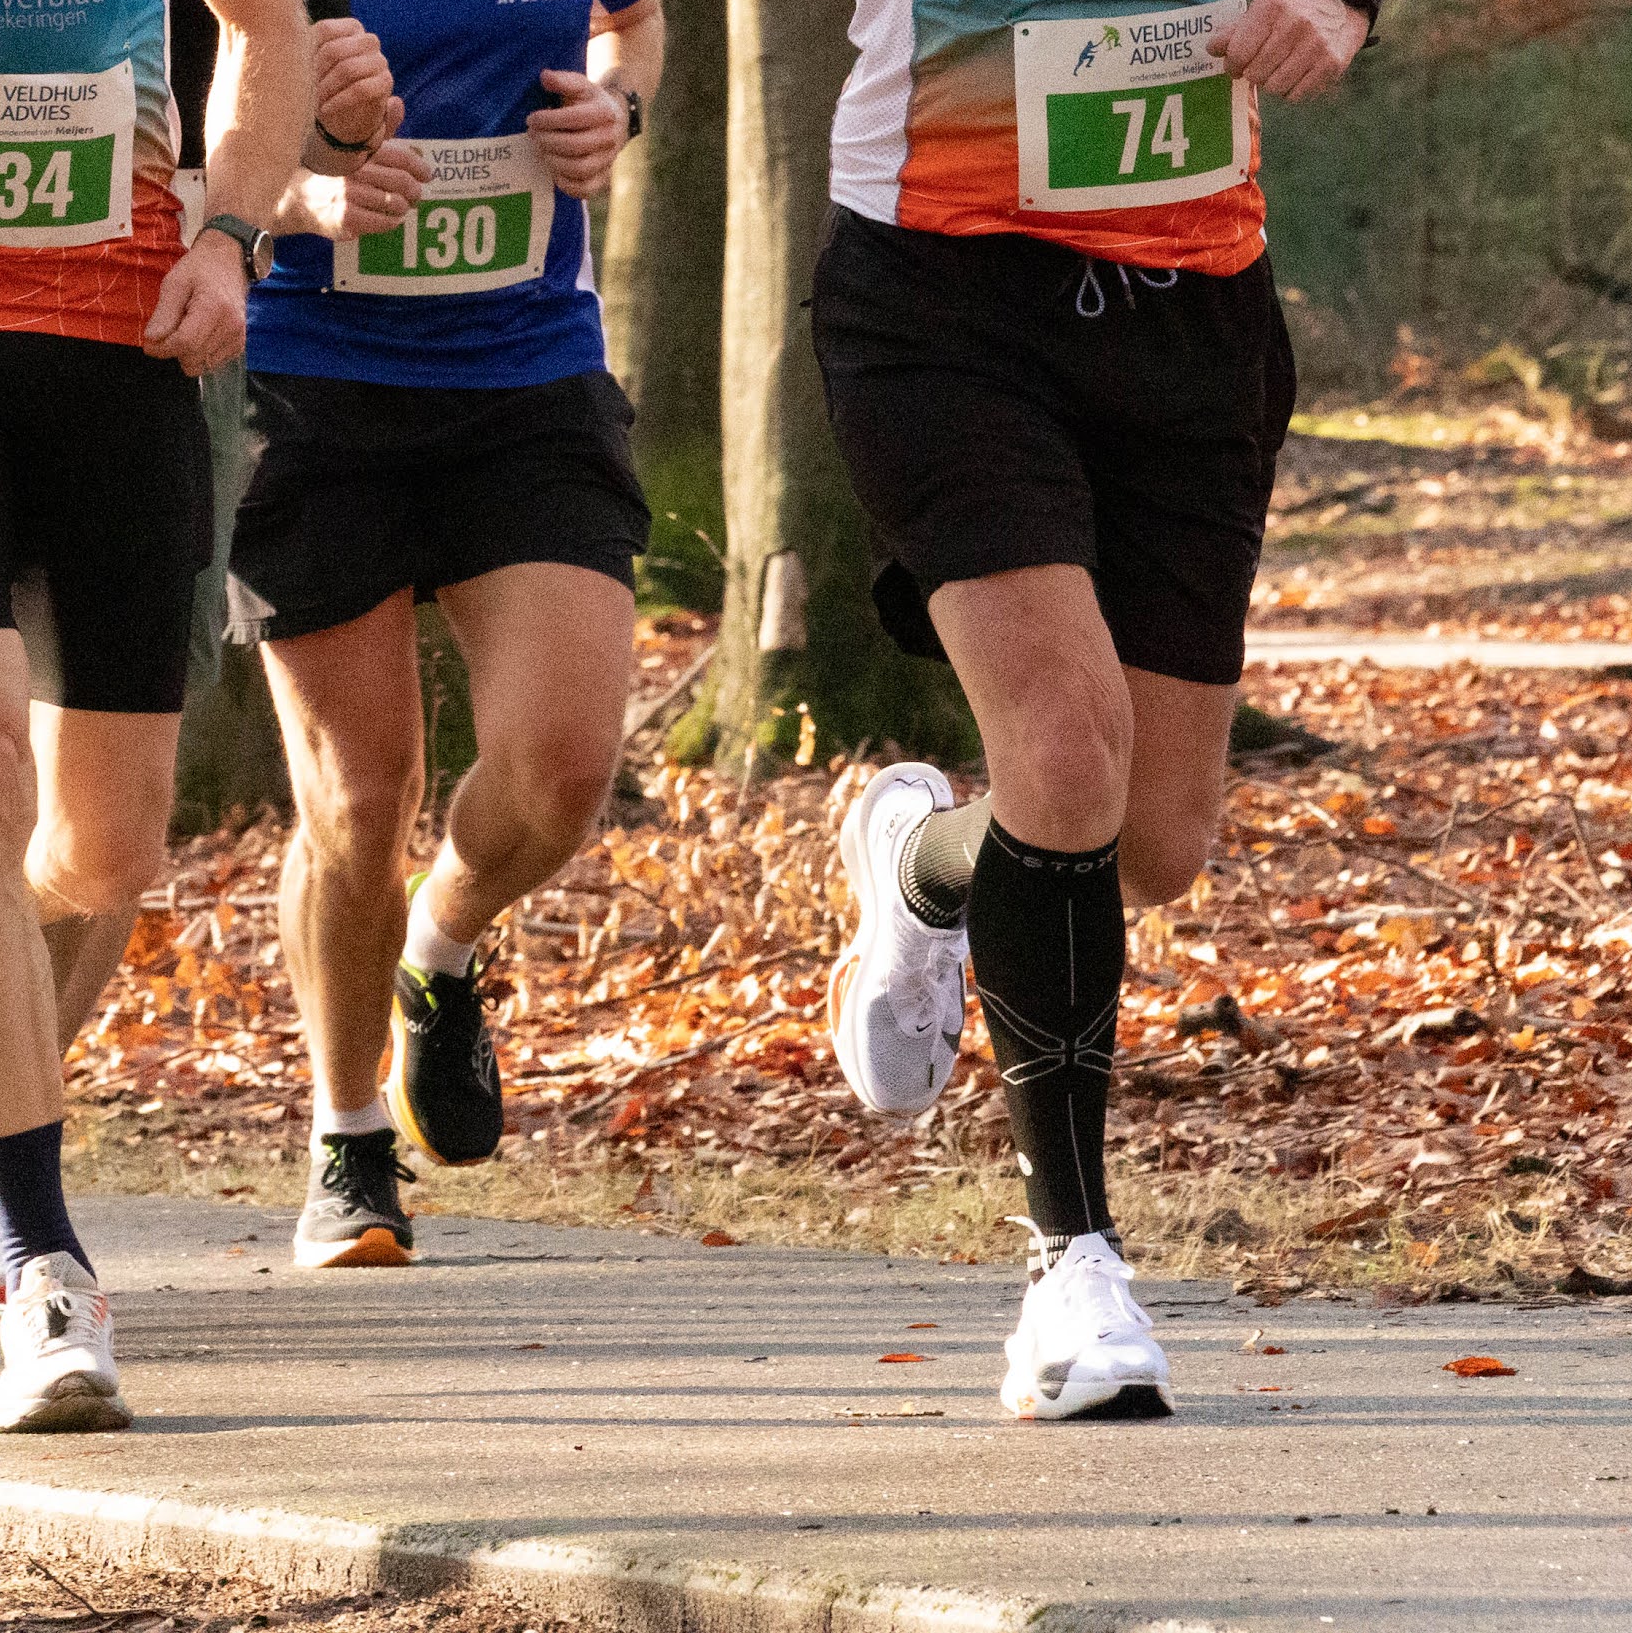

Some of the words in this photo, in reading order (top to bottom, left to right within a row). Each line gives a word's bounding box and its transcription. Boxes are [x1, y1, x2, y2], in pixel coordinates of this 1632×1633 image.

[1129, 14, 1213, 44] VELDHUIS
[1129, 40, 1193, 66] ADVIES
[3, 84, 98, 102] VELDHUIS
[0, 105, 71, 121] ADVIES
[55, 125, 94, 136] Meijers
[1112, 92, 1191, 175] 74
[431, 145, 511, 164] VELDHUIS
[431, 165, 490, 182] ADVIES
[403, 204, 497, 269] 130
